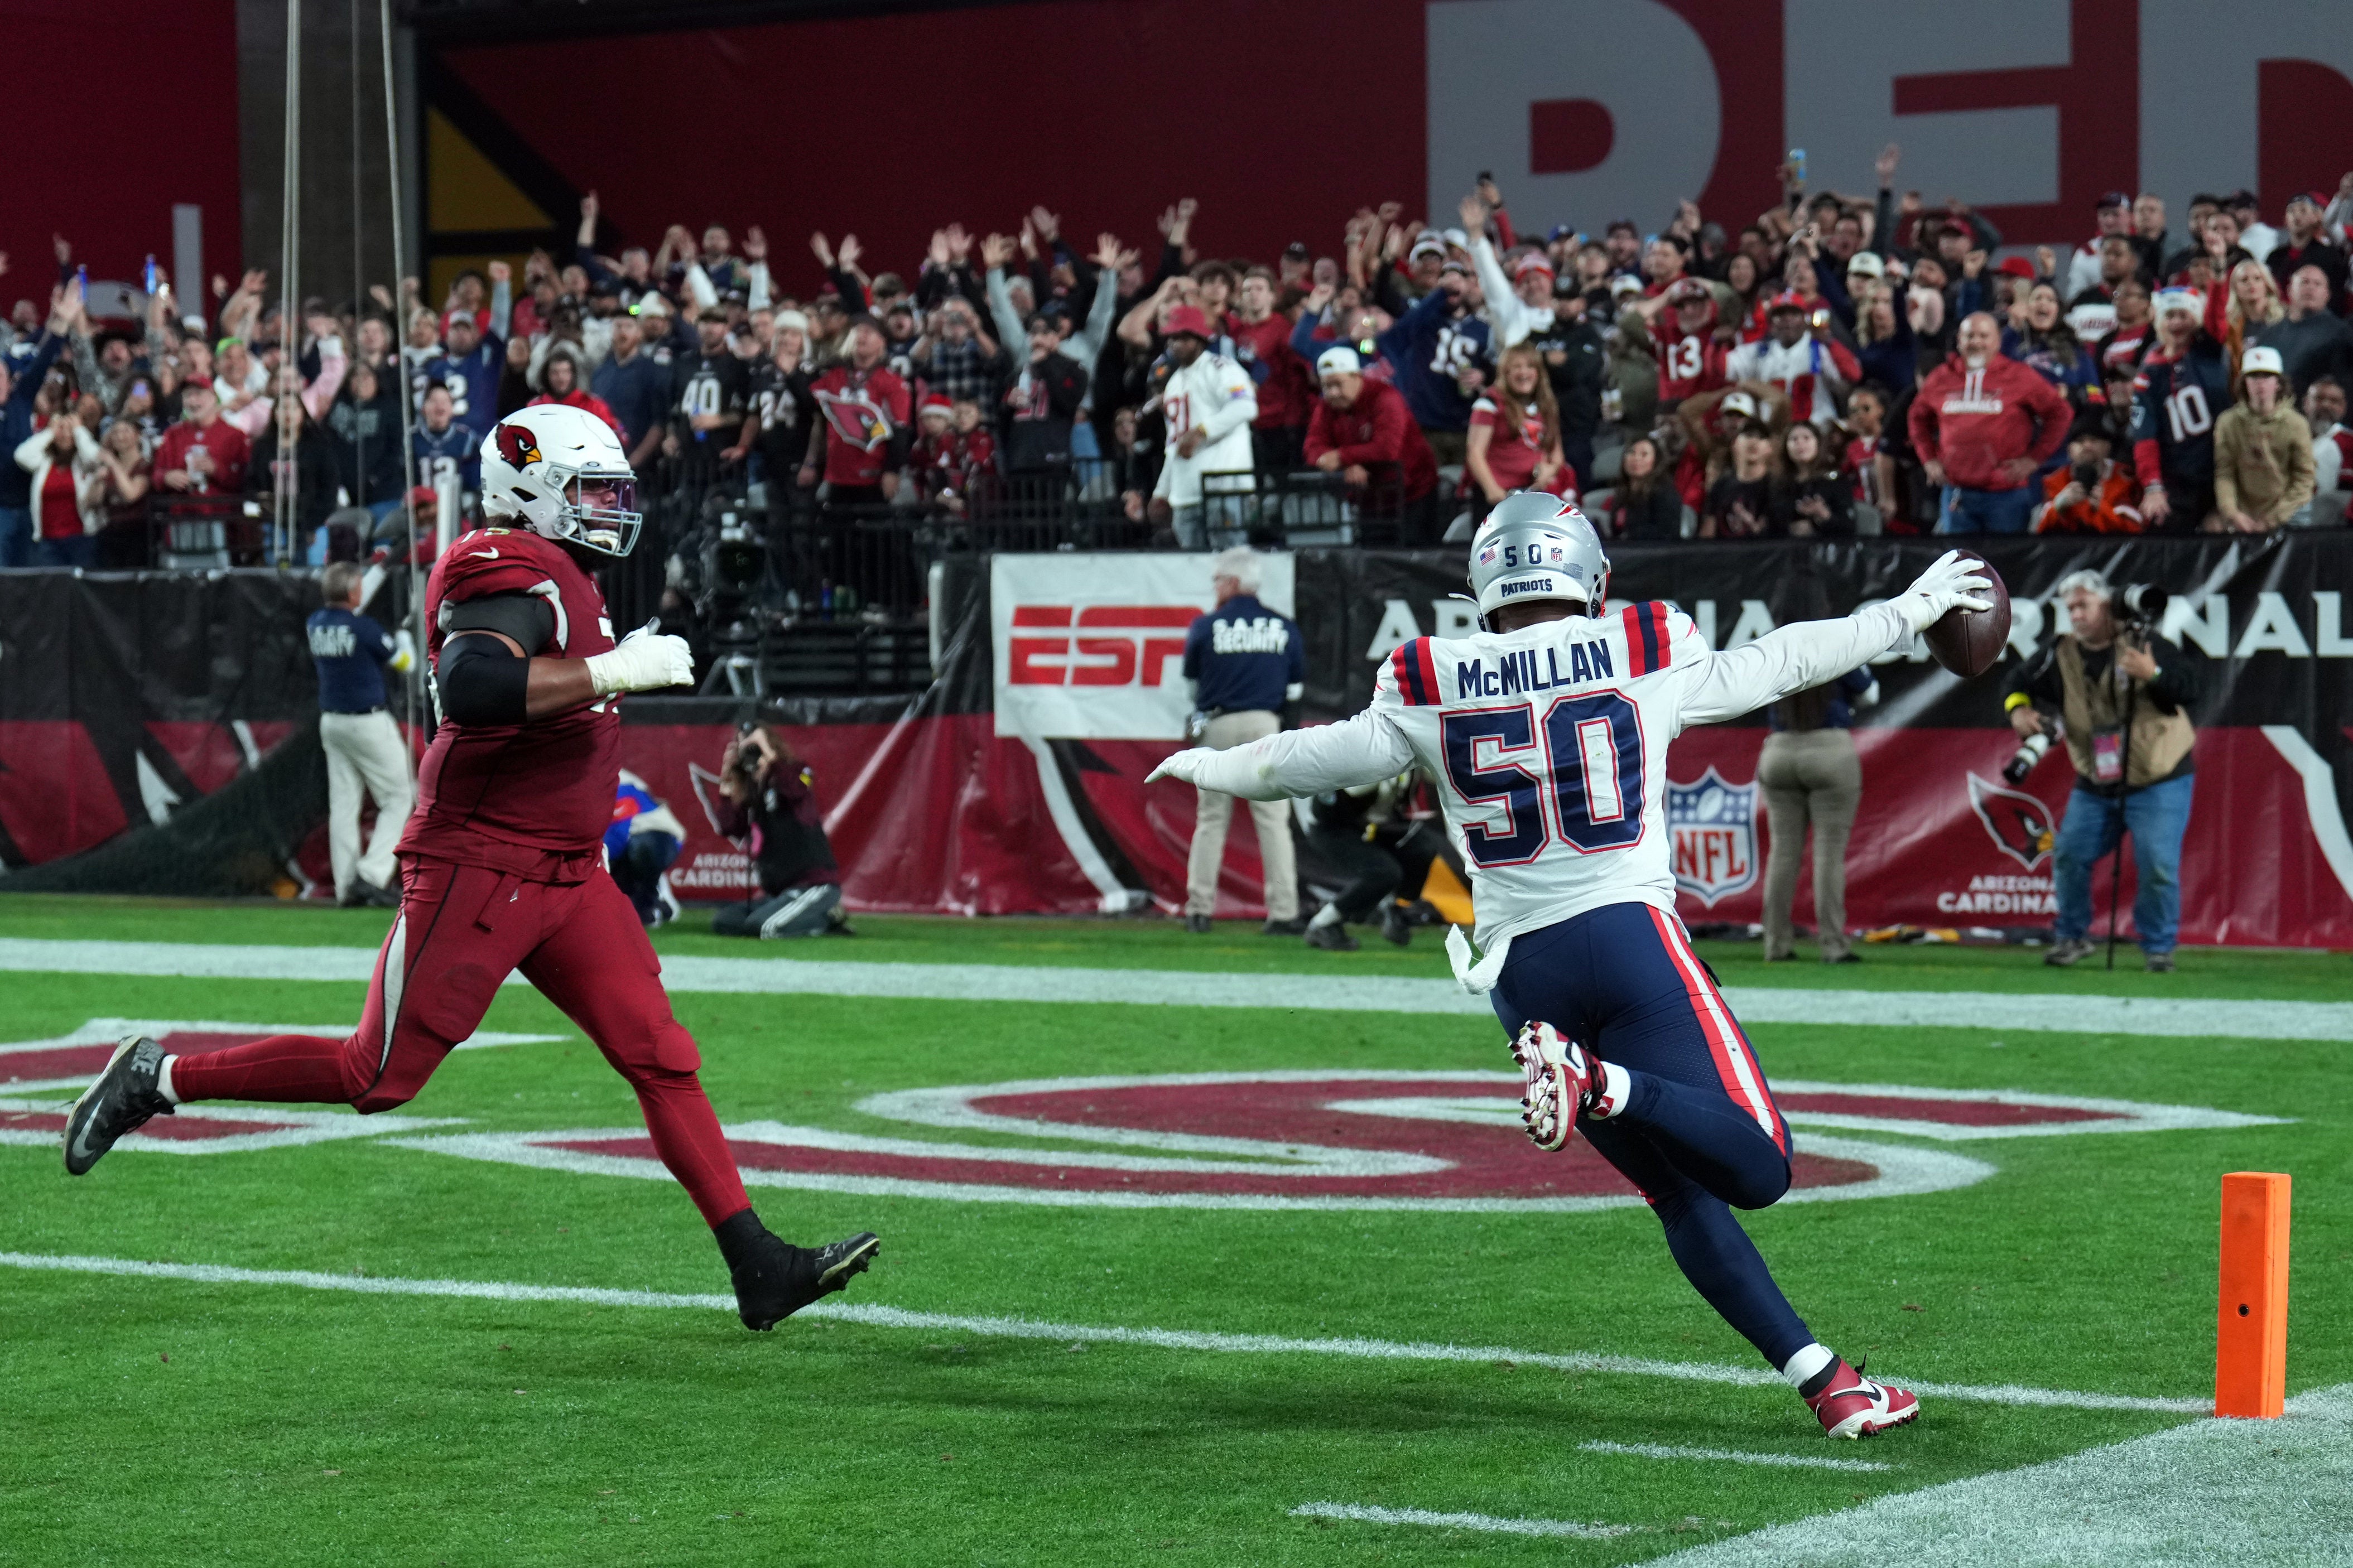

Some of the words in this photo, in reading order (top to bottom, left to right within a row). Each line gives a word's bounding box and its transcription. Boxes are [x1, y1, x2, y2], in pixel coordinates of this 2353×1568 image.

[1667, 335, 1702, 383] 13
[681, 378, 721, 417] 40
[2164, 384, 2212, 443] 10
[1501, 578, 1552, 597] PATRIOTS
[1009, 606, 1204, 687] ESP
[1457, 638, 1614, 699] McMILLAN
[1438, 688, 1646, 869] 50
[670, 868, 761, 887] CARDINA
[692, 853, 755, 869] ARIZON
[1676, 830, 1745, 884] NFL
[1937, 892, 2060, 914] CARDINA
